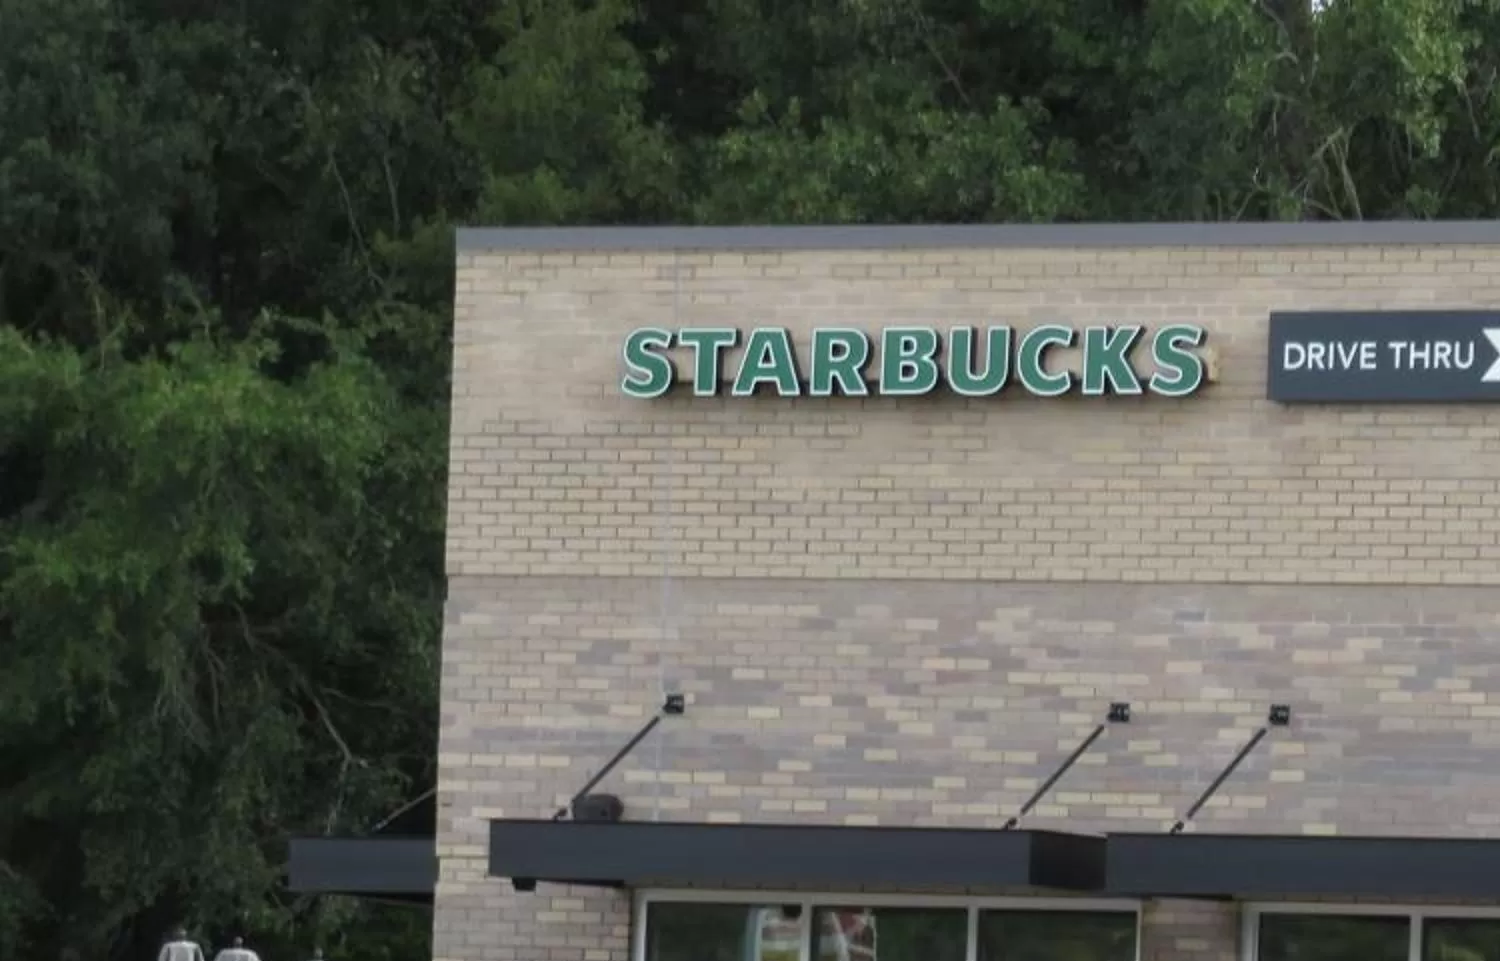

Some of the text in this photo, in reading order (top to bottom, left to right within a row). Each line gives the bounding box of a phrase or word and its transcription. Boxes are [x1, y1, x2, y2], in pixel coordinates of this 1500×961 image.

[620, 324, 1205, 397] STARBUCKS
[1282, 340, 1476, 370] DRIVE THRU
